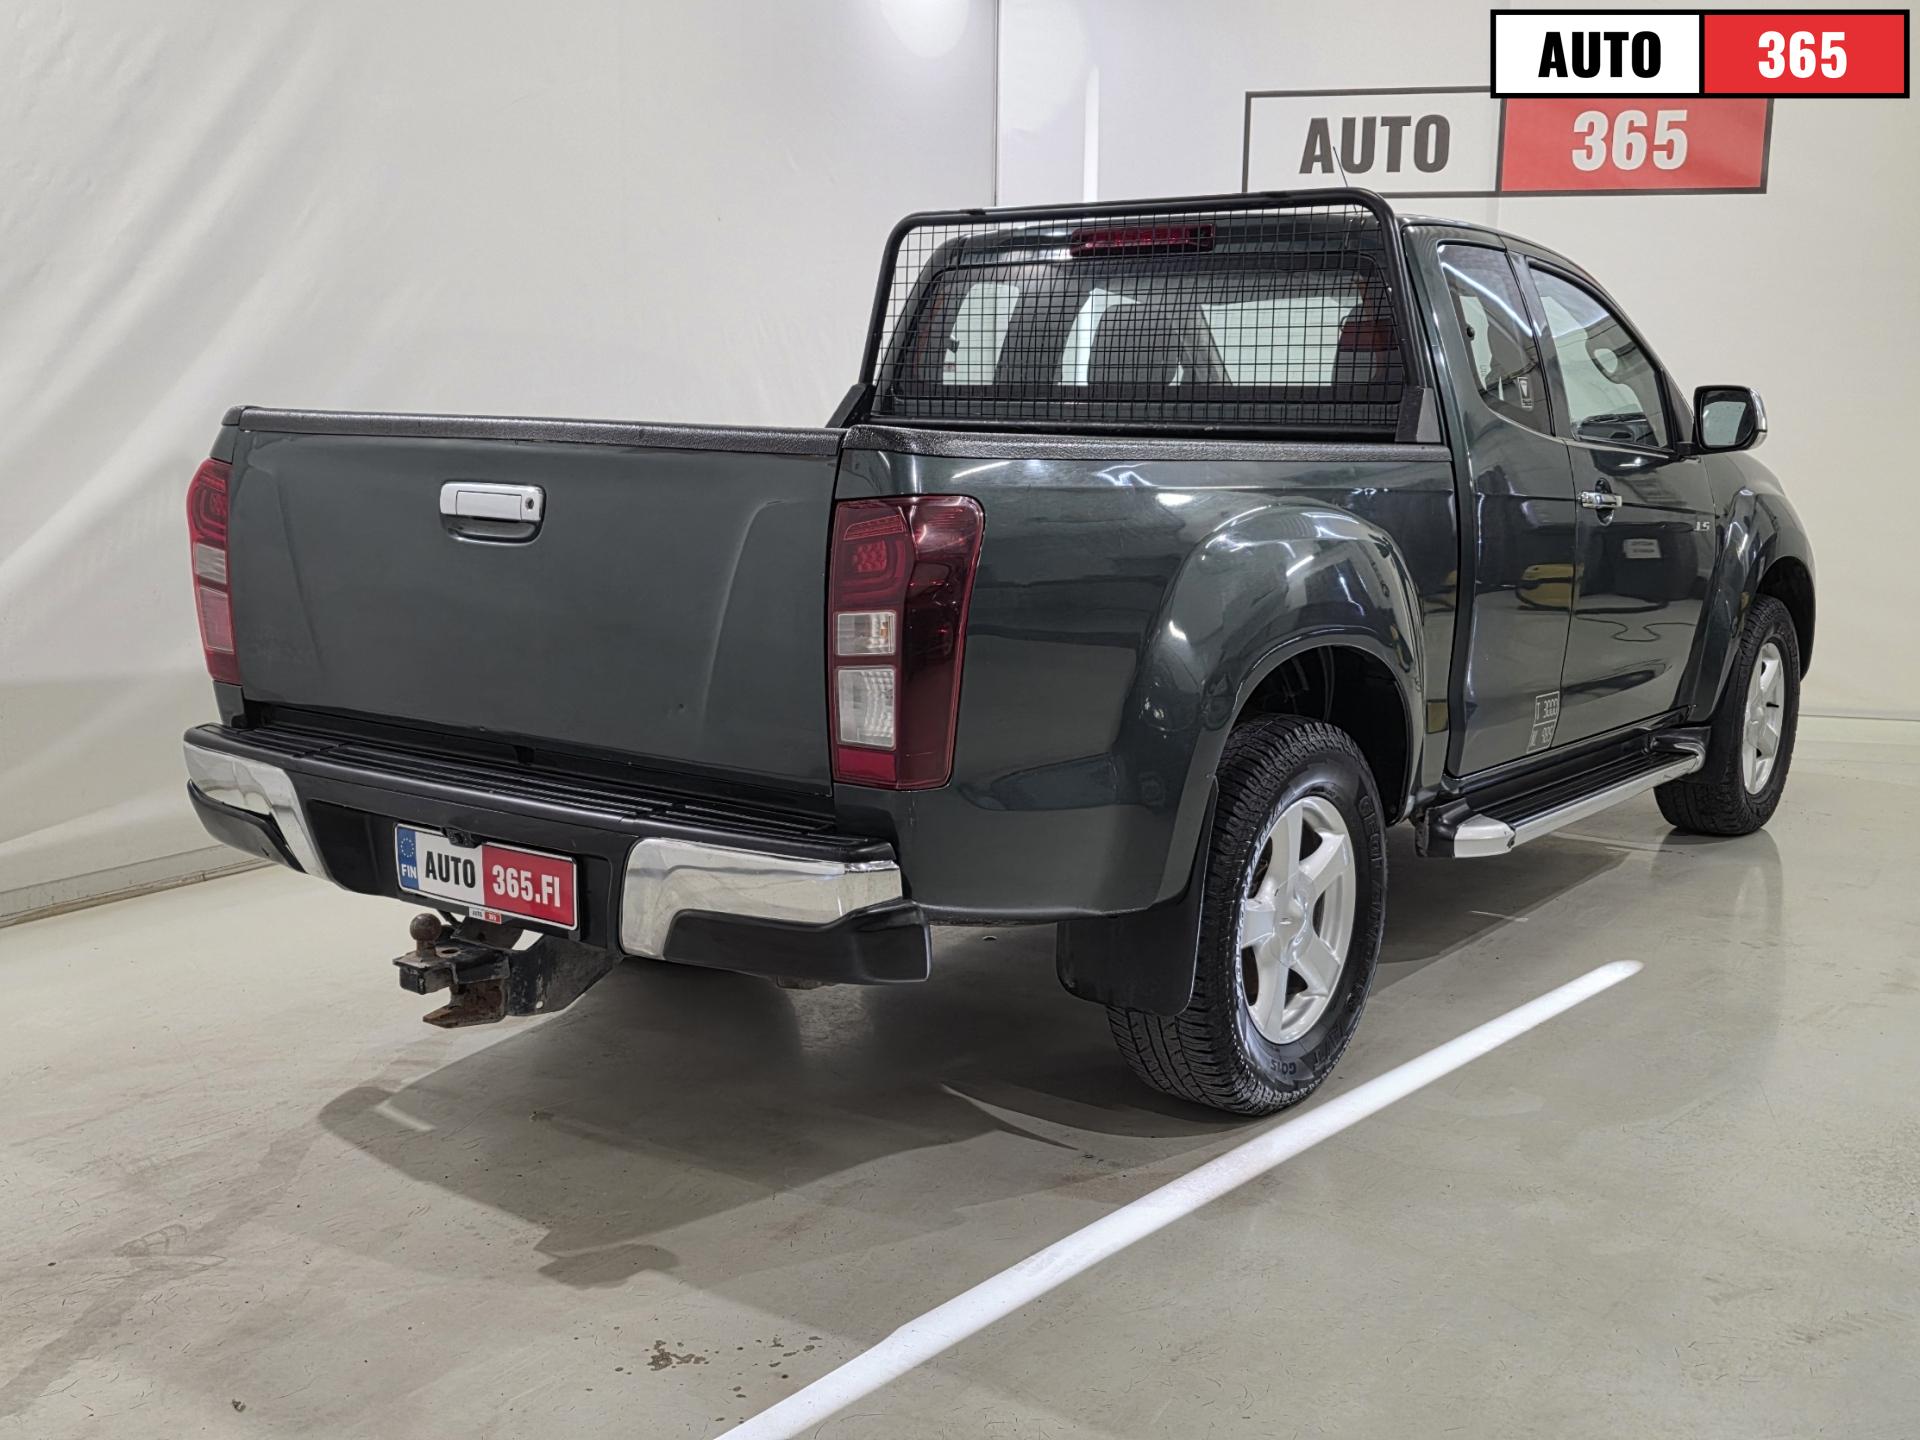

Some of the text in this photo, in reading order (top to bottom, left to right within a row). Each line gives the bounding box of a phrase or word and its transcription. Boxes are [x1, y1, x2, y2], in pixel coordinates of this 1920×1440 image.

[1298, 109, 1690, 175] AUTO 365
[401, 851, 561, 908] FIN AUTO 365.FI
